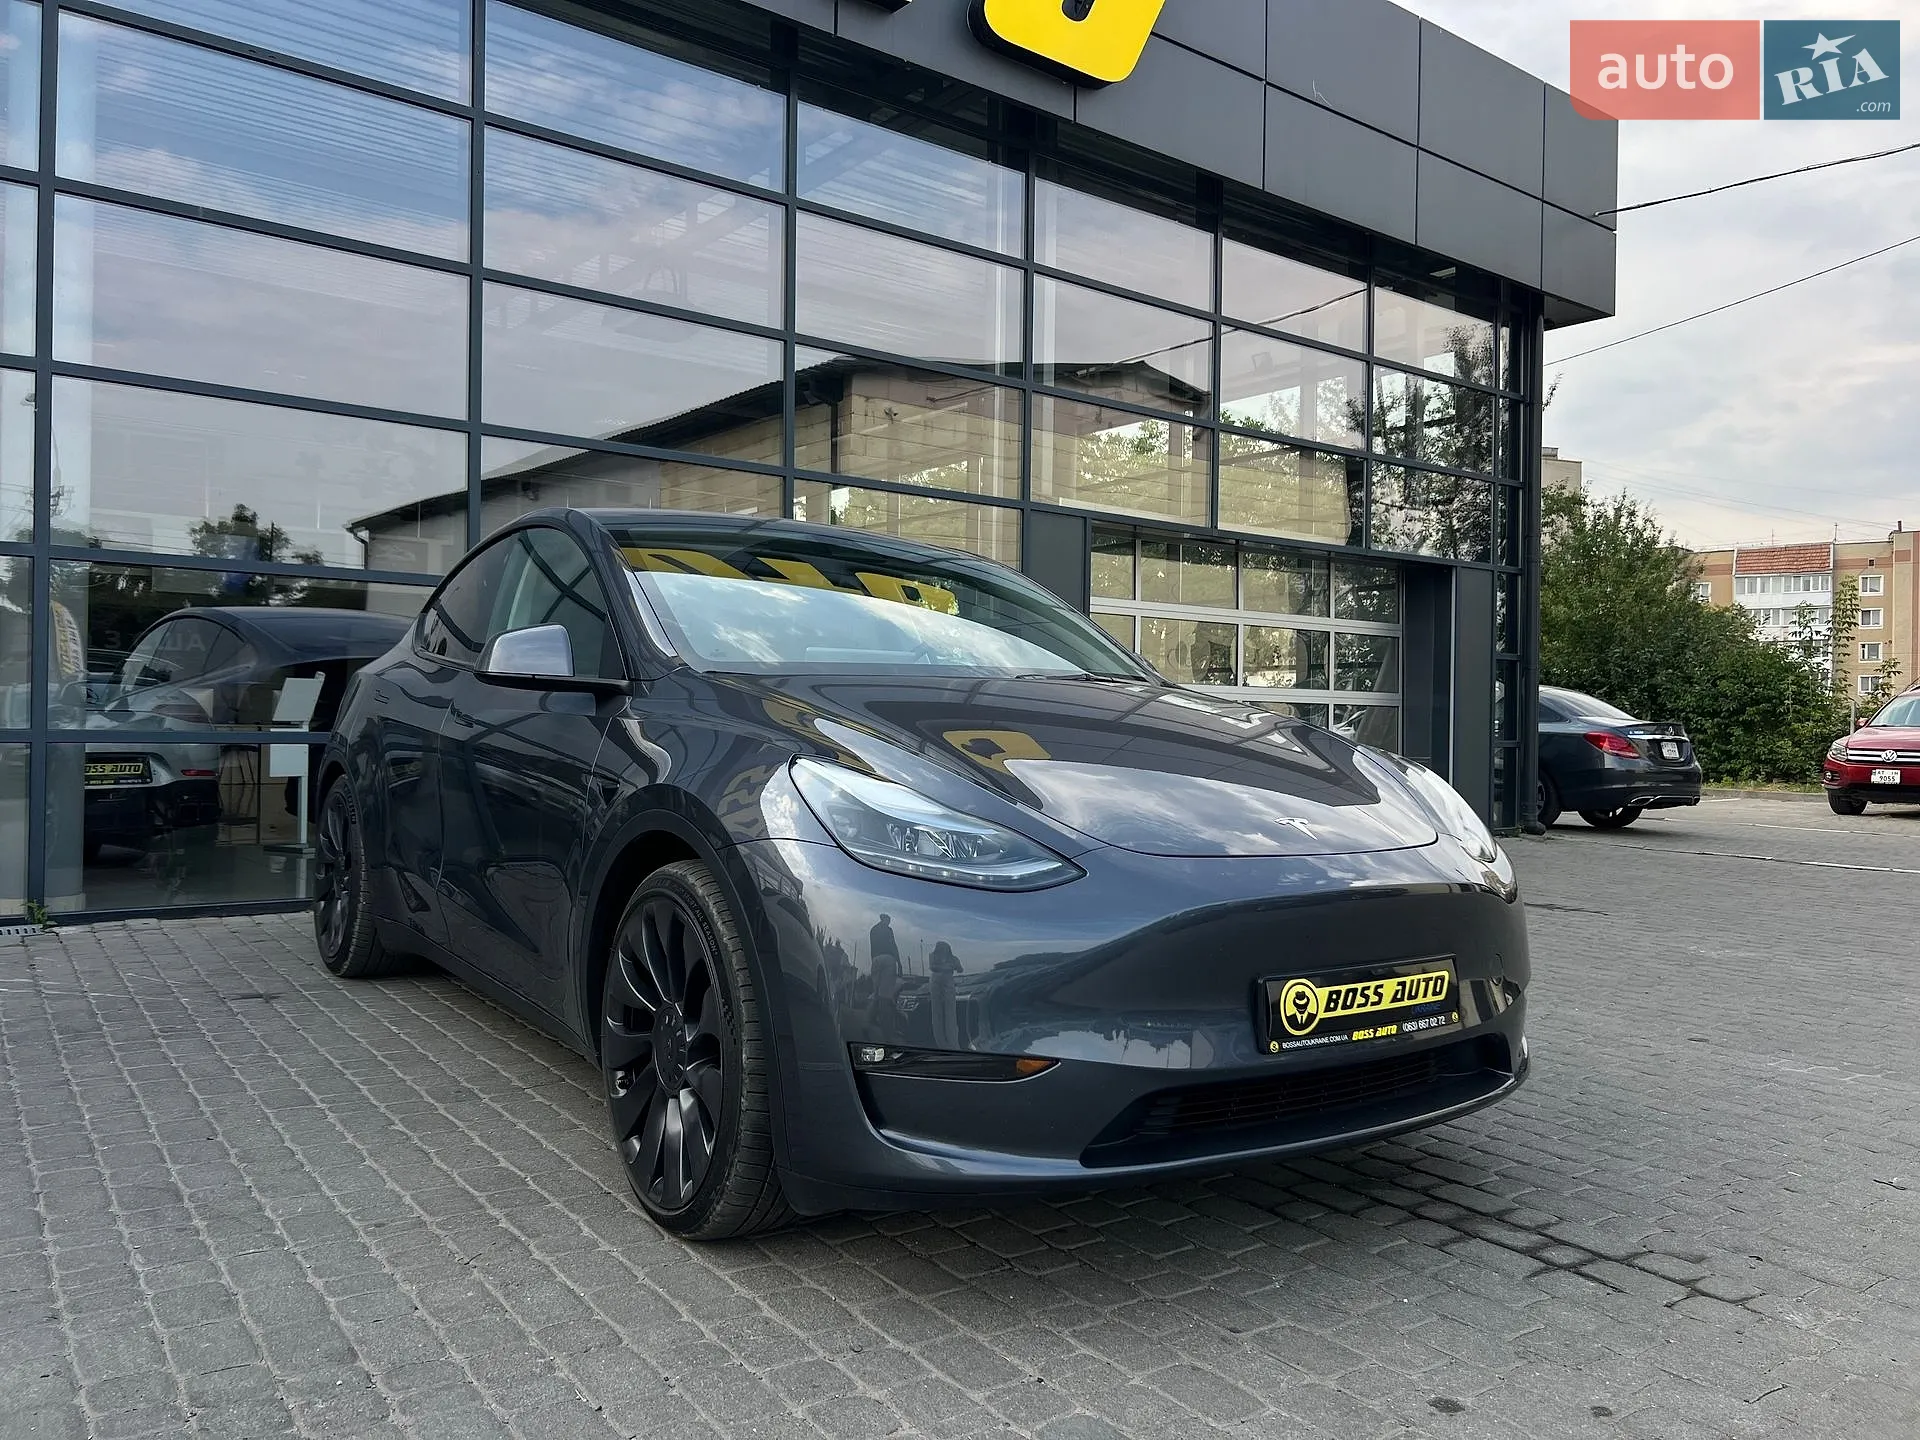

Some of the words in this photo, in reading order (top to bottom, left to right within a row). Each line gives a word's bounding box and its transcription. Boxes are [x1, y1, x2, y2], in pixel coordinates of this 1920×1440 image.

[110, 764, 142, 773] AUTO
[1323, 984, 1384, 1013] BOSS
[1389, 974, 1445, 1004] AUTO
[1352, 1028, 1374, 1041] BOSS
[1375, 1024, 1398, 1037] AUTO
